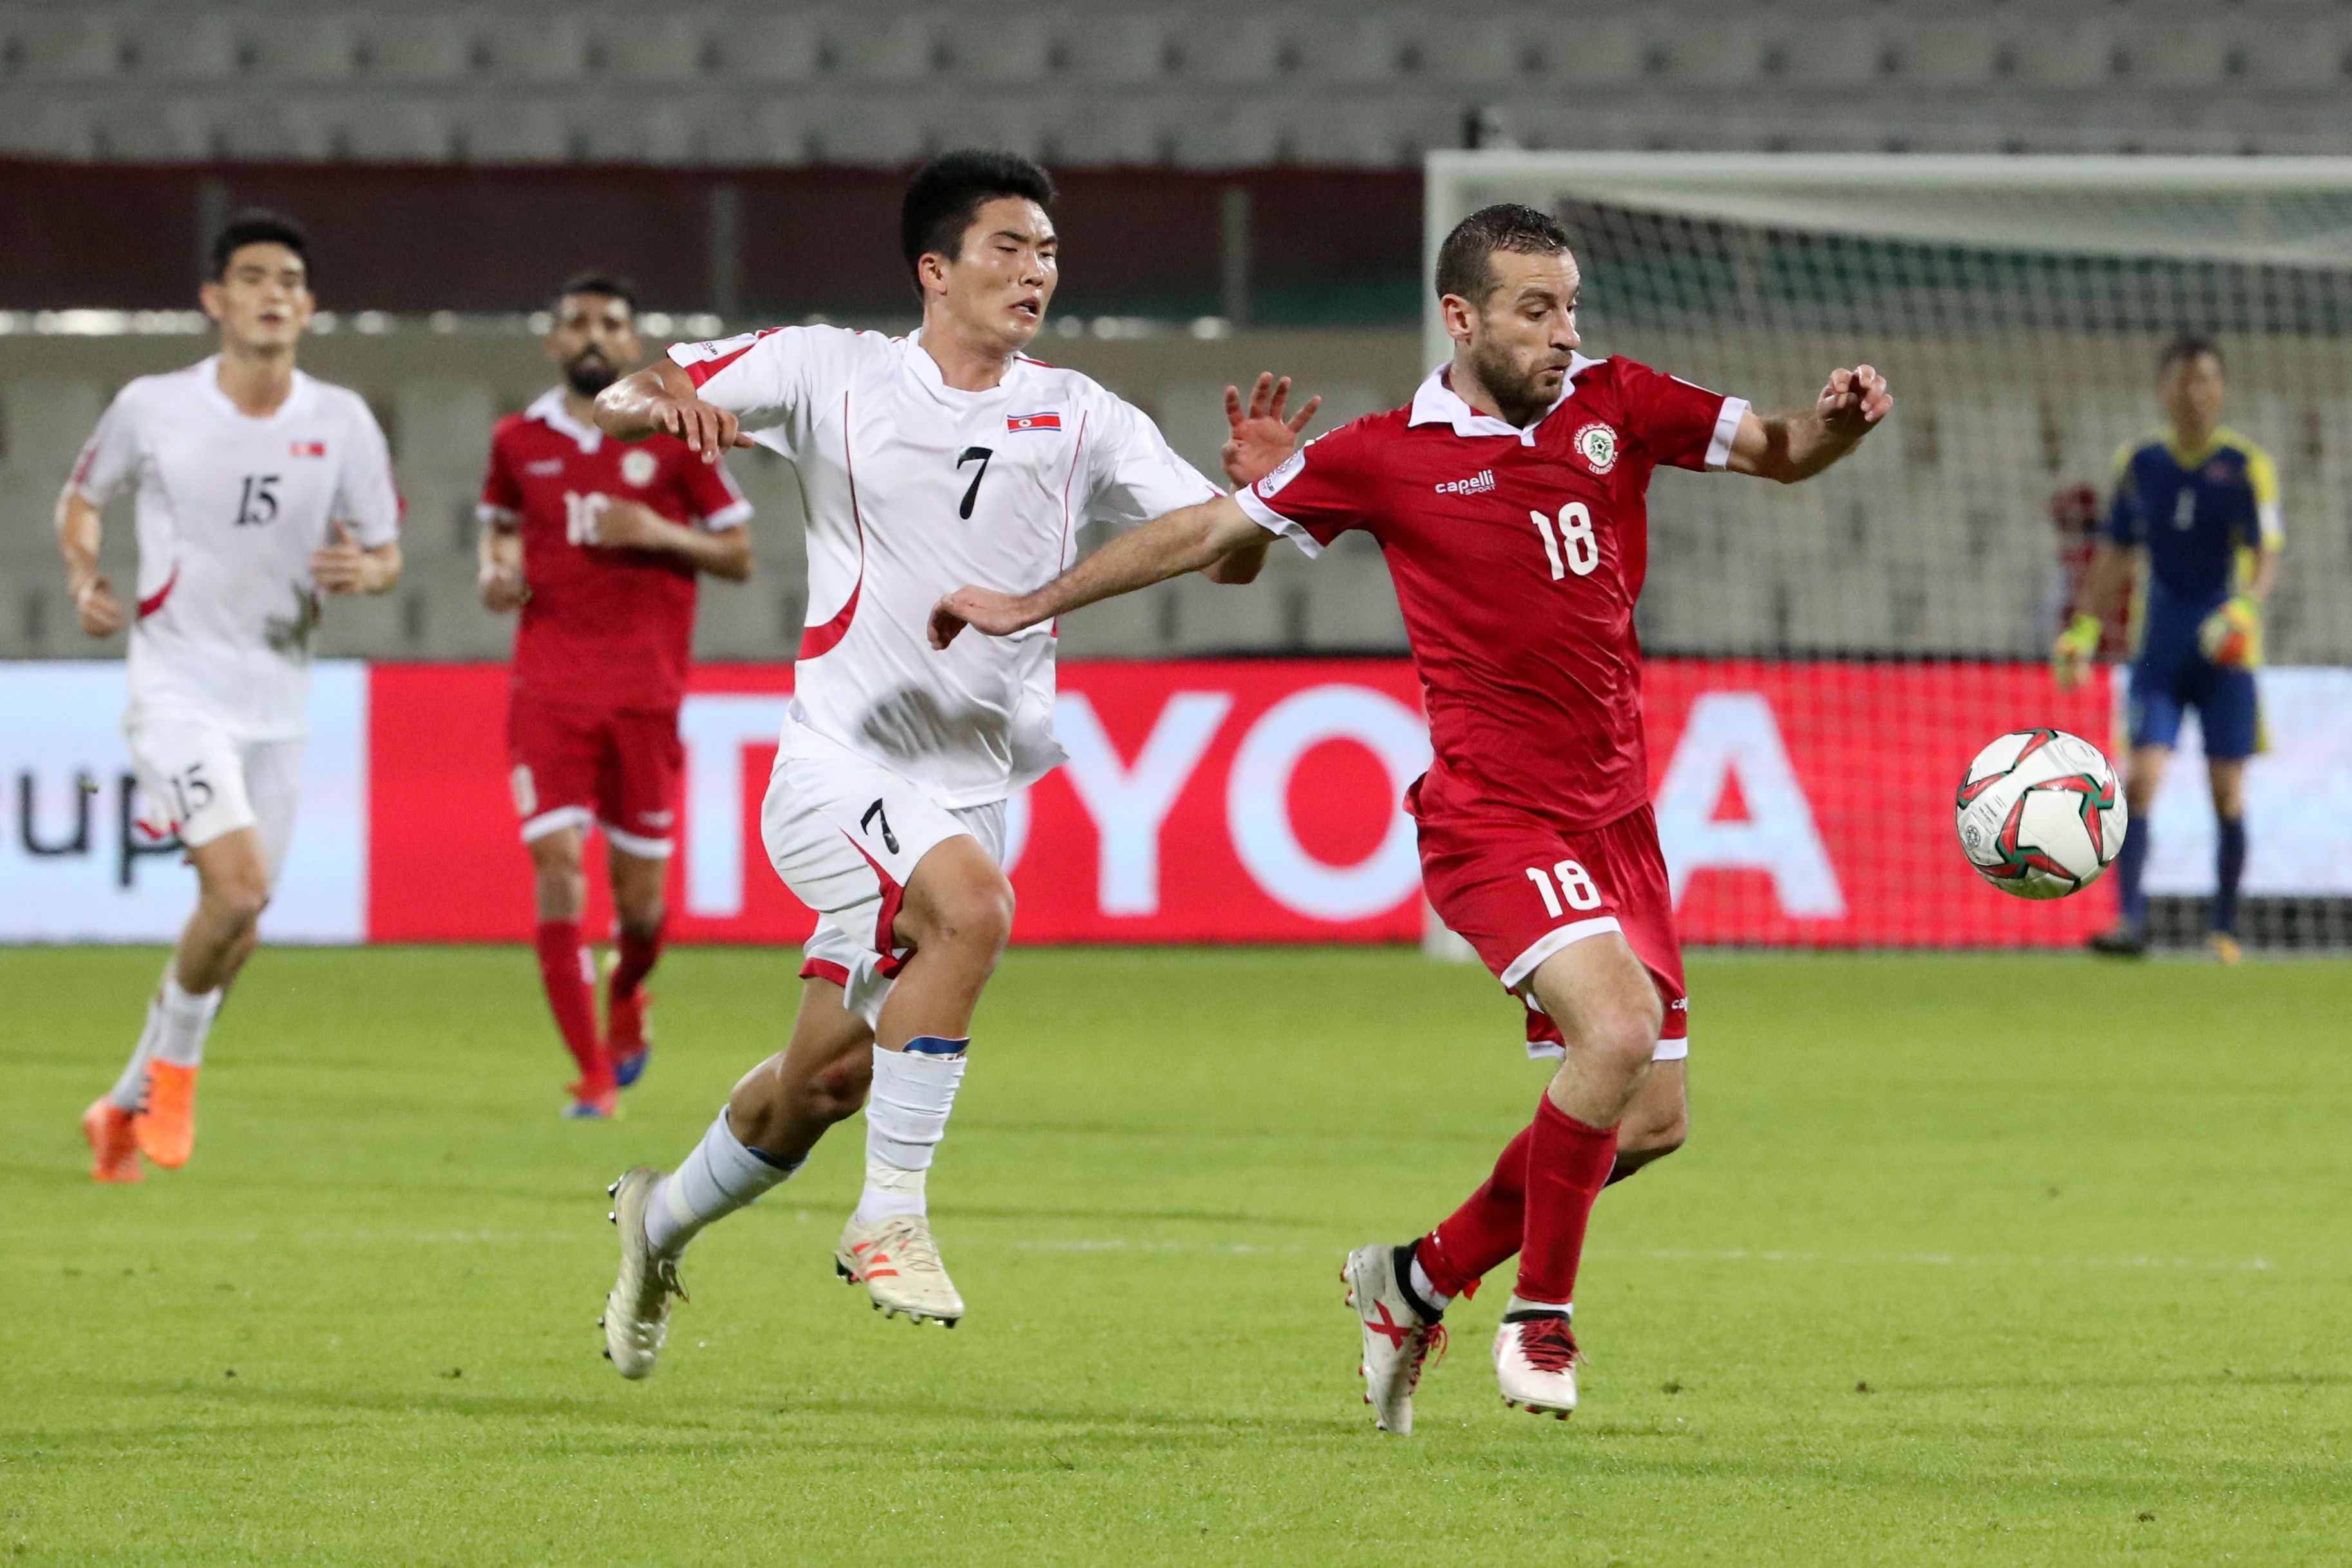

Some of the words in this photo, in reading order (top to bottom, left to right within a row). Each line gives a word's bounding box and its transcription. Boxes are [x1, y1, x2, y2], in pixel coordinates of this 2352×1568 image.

[233, 474, 280, 526] 15
[956, 446, 994, 520] 7
[1435, 469, 1495, 495] capelli
[1465, 484, 1496, 495] SPORT
[1530, 502, 1598, 581] 18
[170, 762, 214, 822] 15
[679, 683, 1846, 923] TYOA
[860, 797, 900, 855] 7
[1525, 860, 1602, 918] 18
